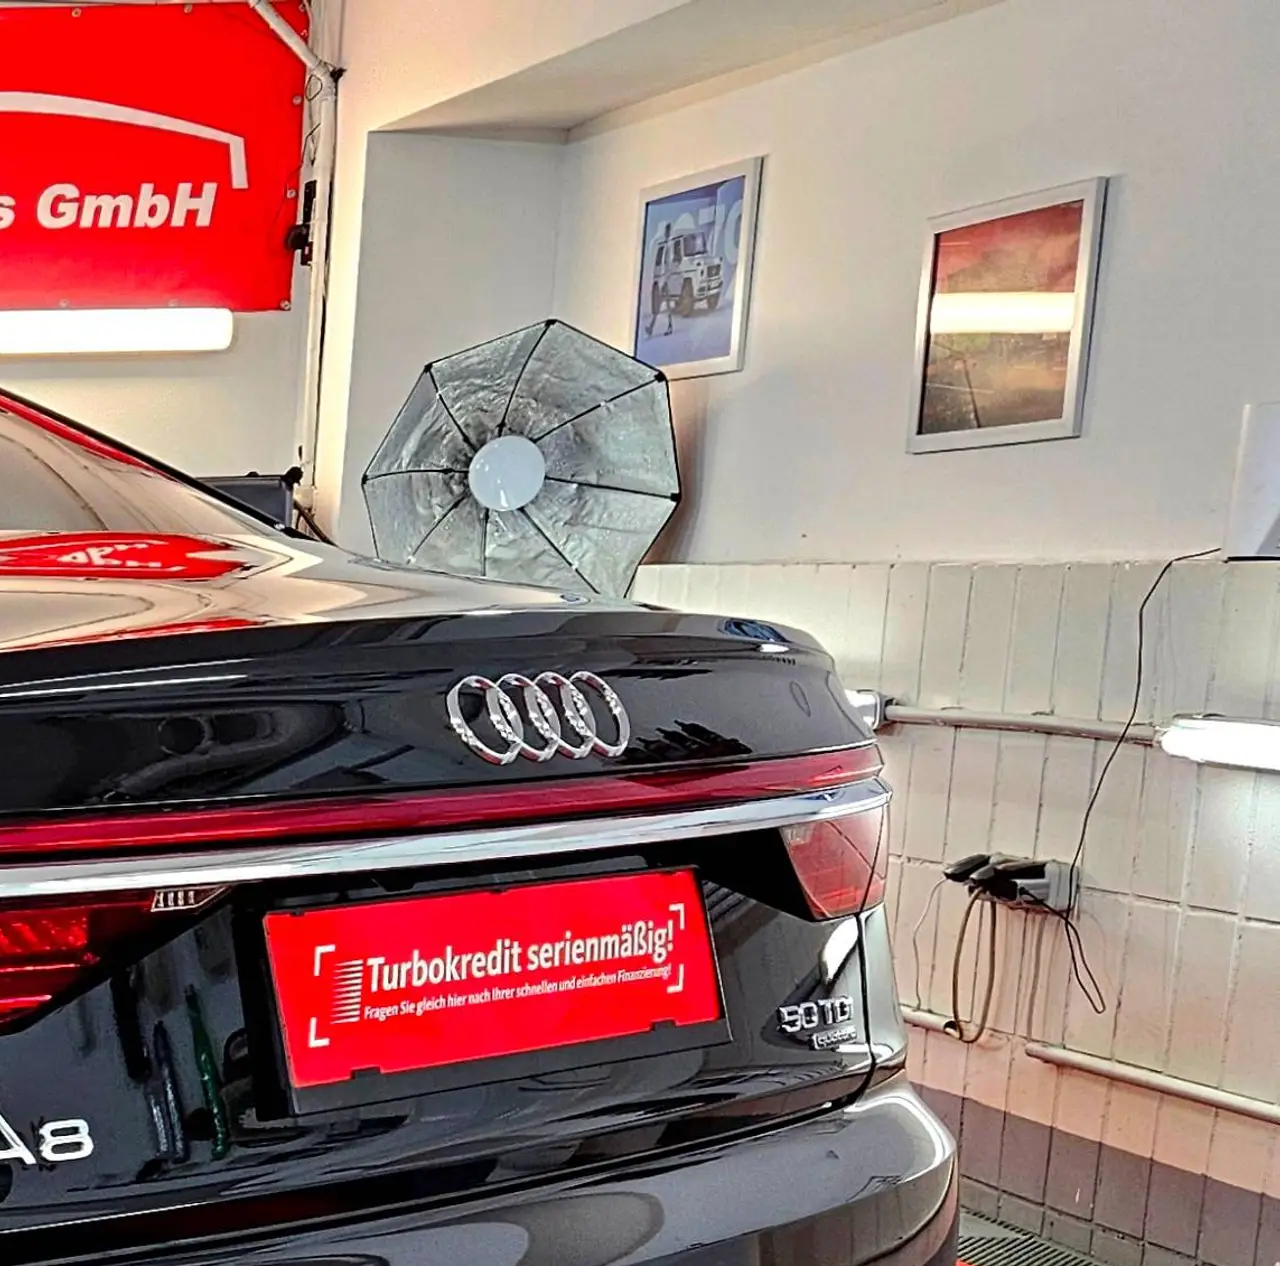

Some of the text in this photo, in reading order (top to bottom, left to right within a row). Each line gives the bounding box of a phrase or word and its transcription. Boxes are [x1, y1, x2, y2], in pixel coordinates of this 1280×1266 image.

[36, 182, 218, 229] GmbH
[367, 919, 675, 993] Turbokredit serienmäßig!
[363, 1005, 399, 1022] Fragen
[400, 1000, 416, 1015] Sie
[416, 994, 446, 1017] gleich
[447, 993, 468, 1008] hier
[468, 988, 490, 1004] nach
[516, 979, 558, 998] schnellen
[558, 976, 576, 991] und
[576, 971, 617, 989] einfachen
[779, 1001, 819, 1034] 50
